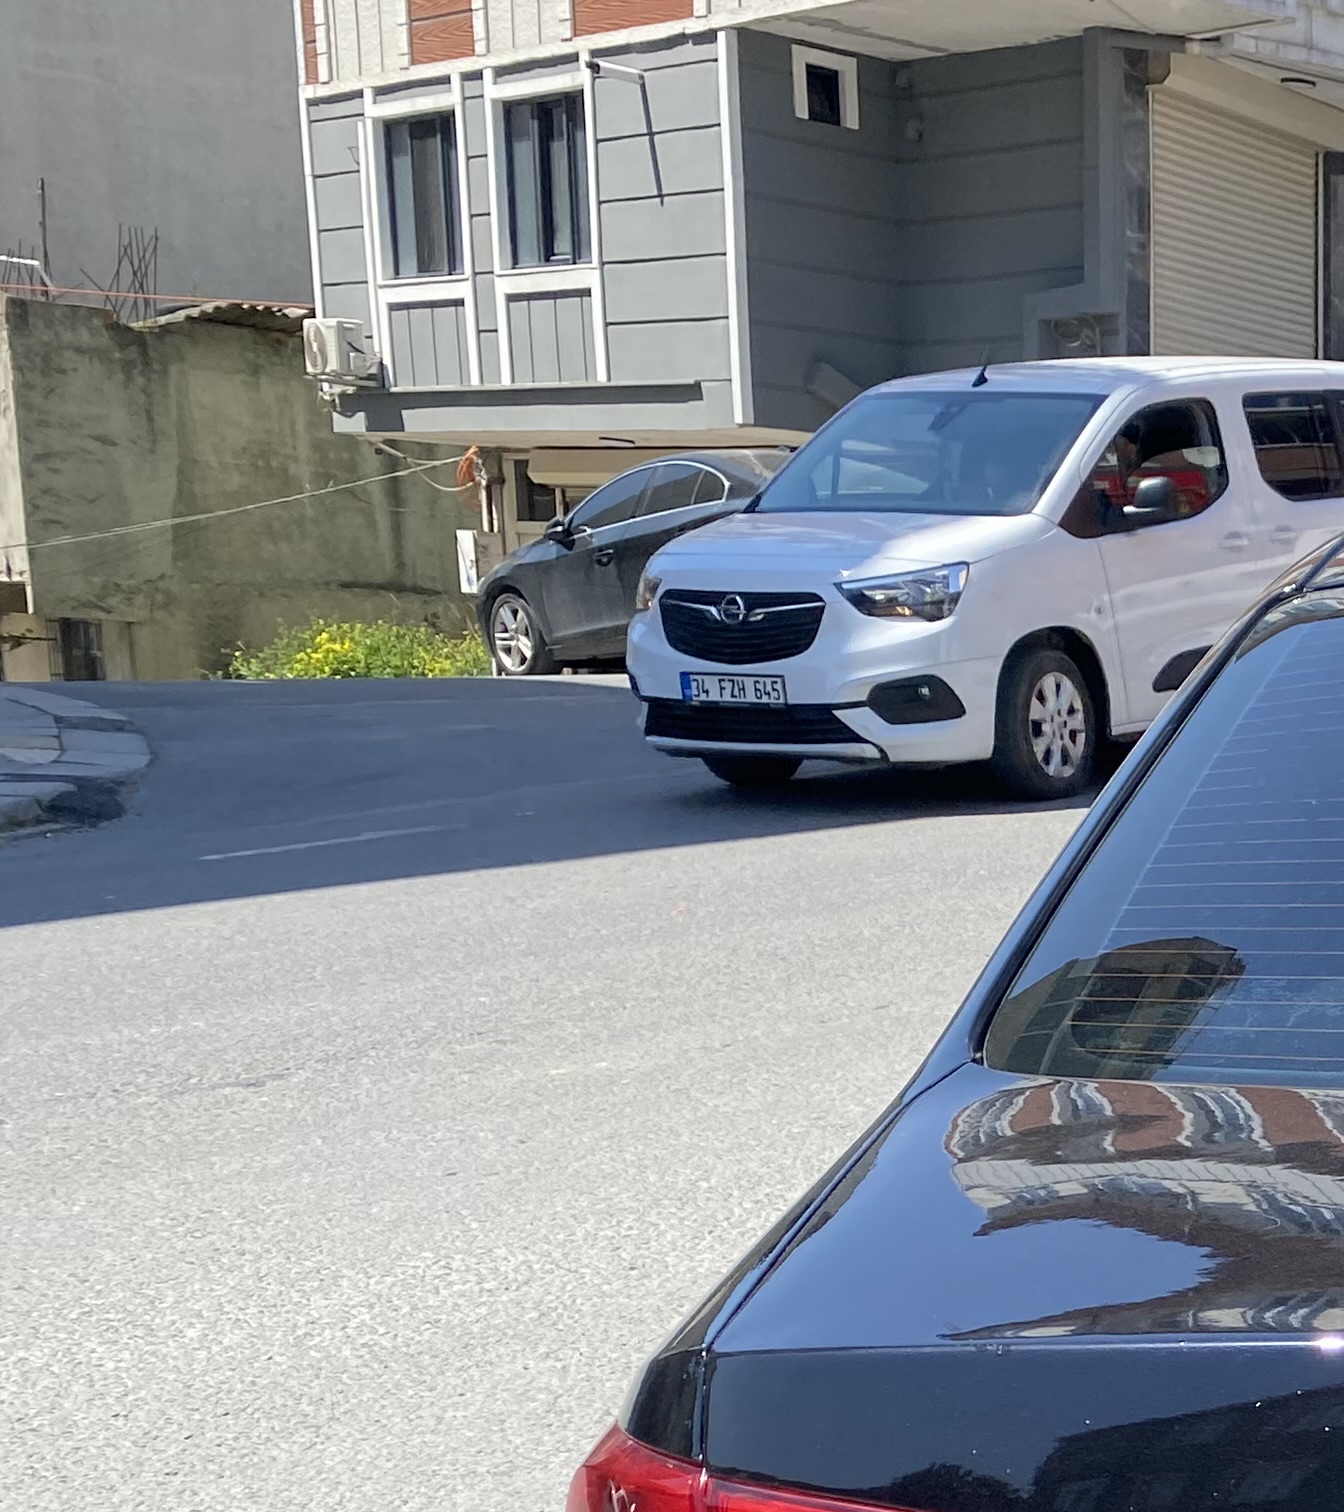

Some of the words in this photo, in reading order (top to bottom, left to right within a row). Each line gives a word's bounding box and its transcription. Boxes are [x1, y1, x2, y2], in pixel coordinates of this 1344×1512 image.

[691, 678, 710, 698] 34
[718, 678, 747, 699] FZH
[753, 680, 781, 701] 645
